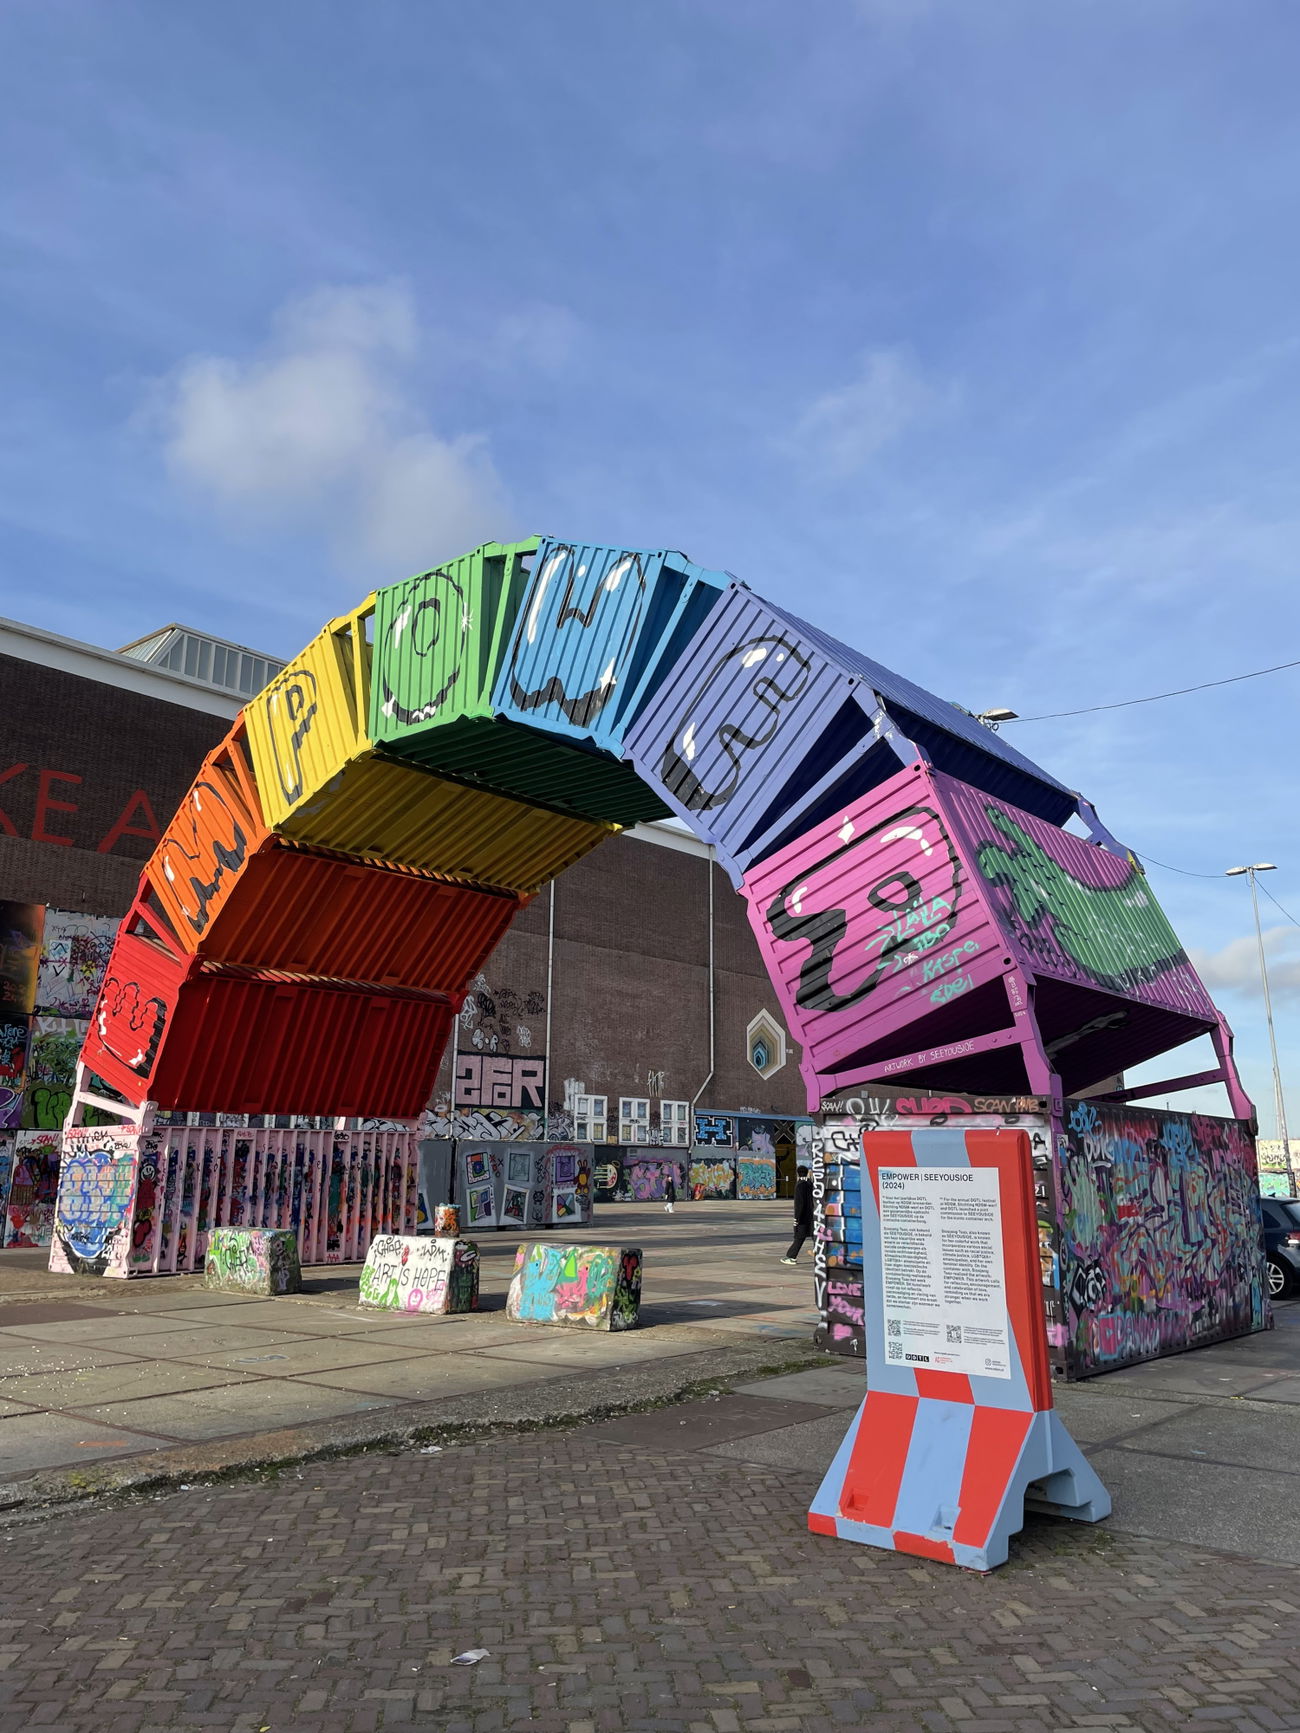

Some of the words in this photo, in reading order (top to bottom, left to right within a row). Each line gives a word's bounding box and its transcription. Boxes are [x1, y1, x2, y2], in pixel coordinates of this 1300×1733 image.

[884, 1059, 913, 1073] ARTWORK
[918, 1053, 927, 1064] BY
[881, 1173, 920, 1181] EMPOWER
[882, 1181, 905, 1190] (2024)
[373, 1263, 398, 1284] ART
[398, 1267, 410, 1287] IS
[412, 1267, 447, 1291] HOPE
